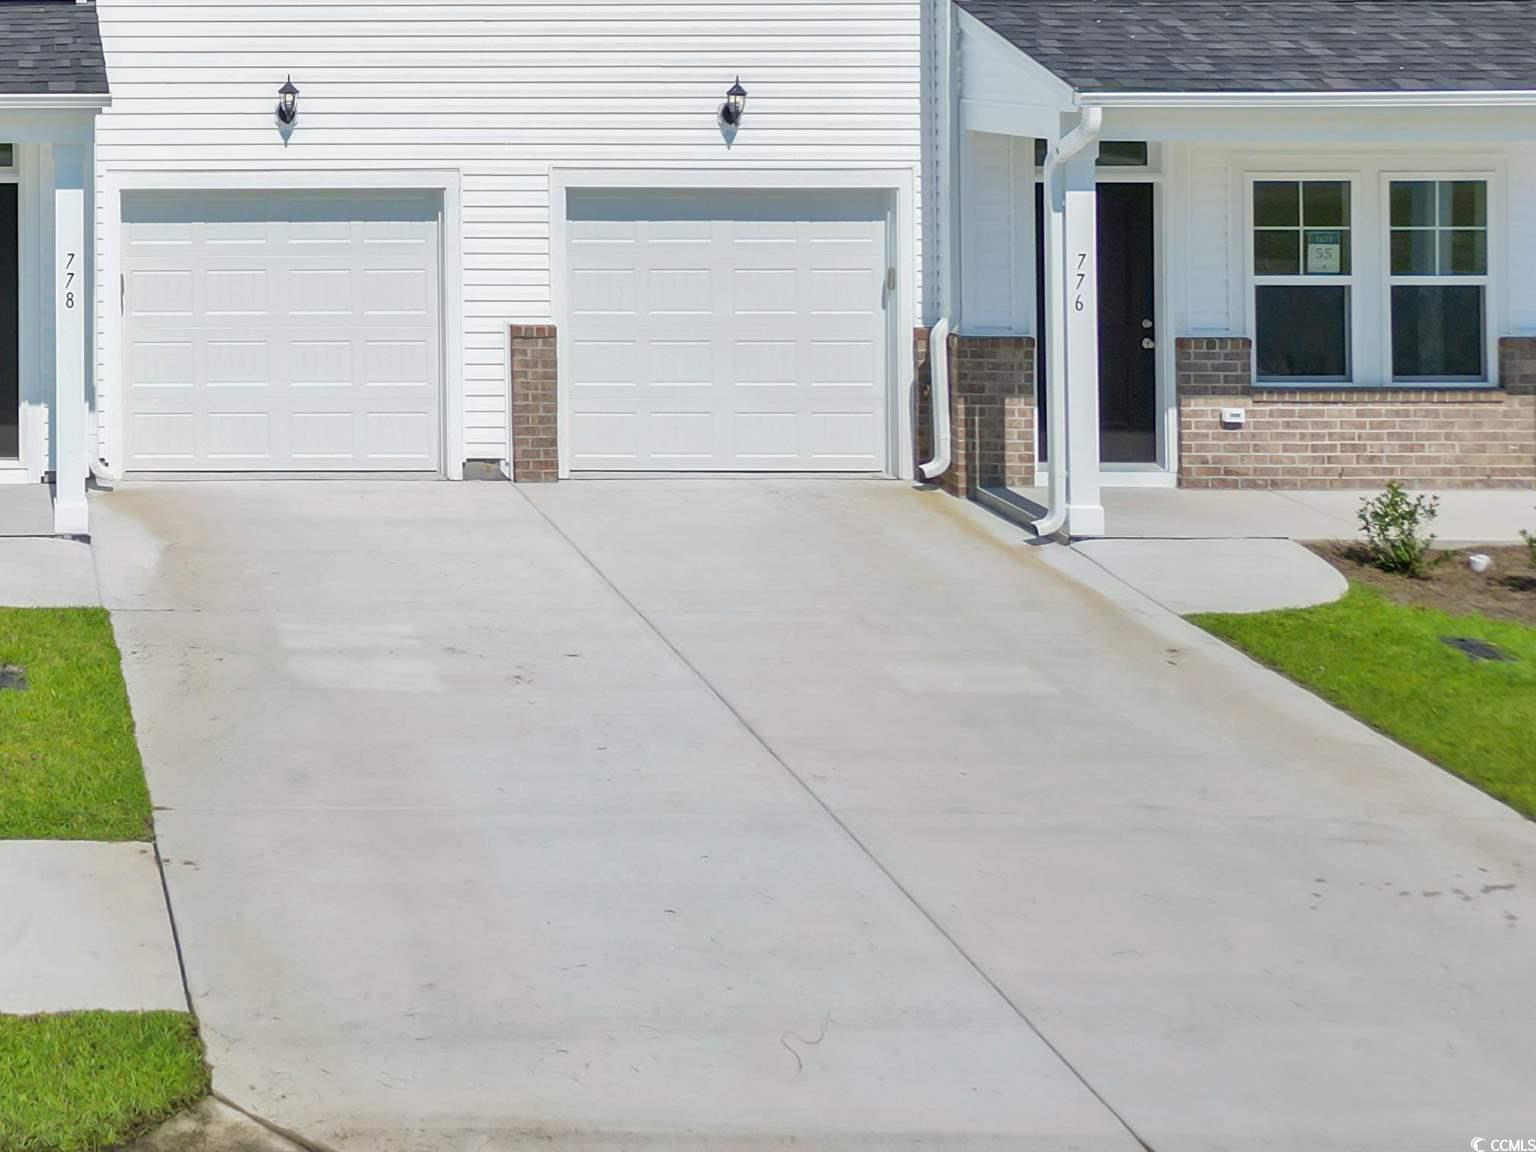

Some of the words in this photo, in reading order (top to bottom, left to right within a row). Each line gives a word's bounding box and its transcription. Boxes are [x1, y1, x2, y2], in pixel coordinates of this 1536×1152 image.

[66, 253, 75, 309] 778
[1315, 247, 1332, 259] 55
[1075, 253, 1086, 311] 776
